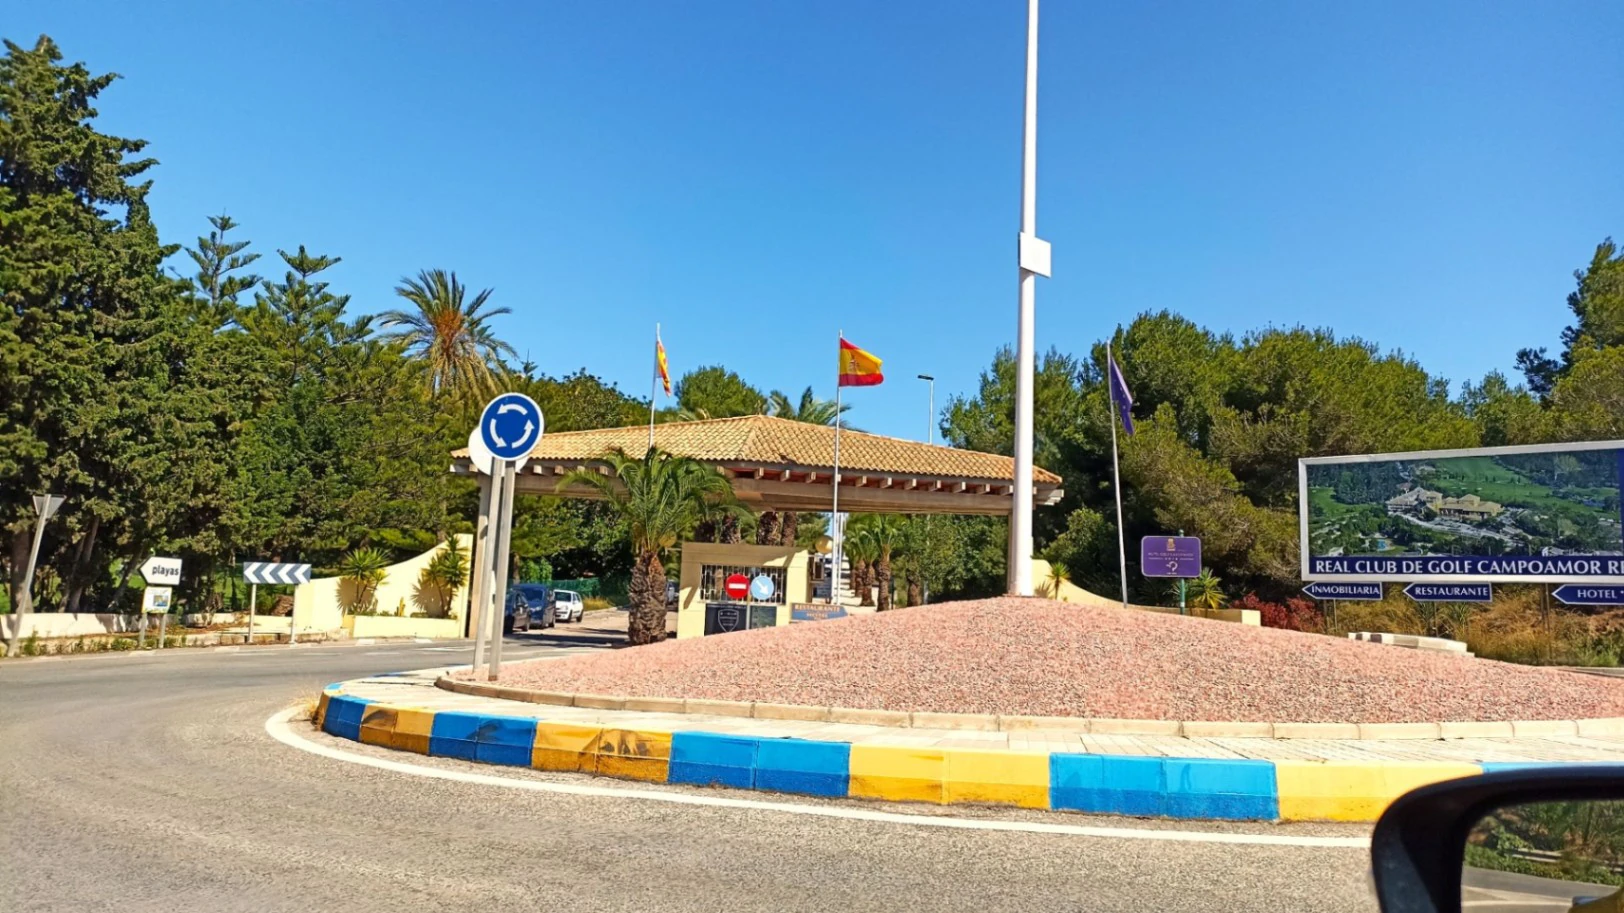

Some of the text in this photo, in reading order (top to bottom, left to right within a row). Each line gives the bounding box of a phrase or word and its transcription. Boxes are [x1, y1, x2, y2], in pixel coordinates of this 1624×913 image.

[152, 564, 179, 577] playas
[1315, 560, 1351, 573] REAL
[1355, 560, 1397, 573] CLUB
[1402, 560, 1423, 573] DE
[1427, 560, 1472, 573] GOLF
[1477, 560, 1602, 574] CAMPOAMOR
[1311, 585, 1380, 595] INMOBILIARIA
[1415, 586, 1488, 596] RESTAURANTE
[1577, 589, 1617, 599] HOTEL
